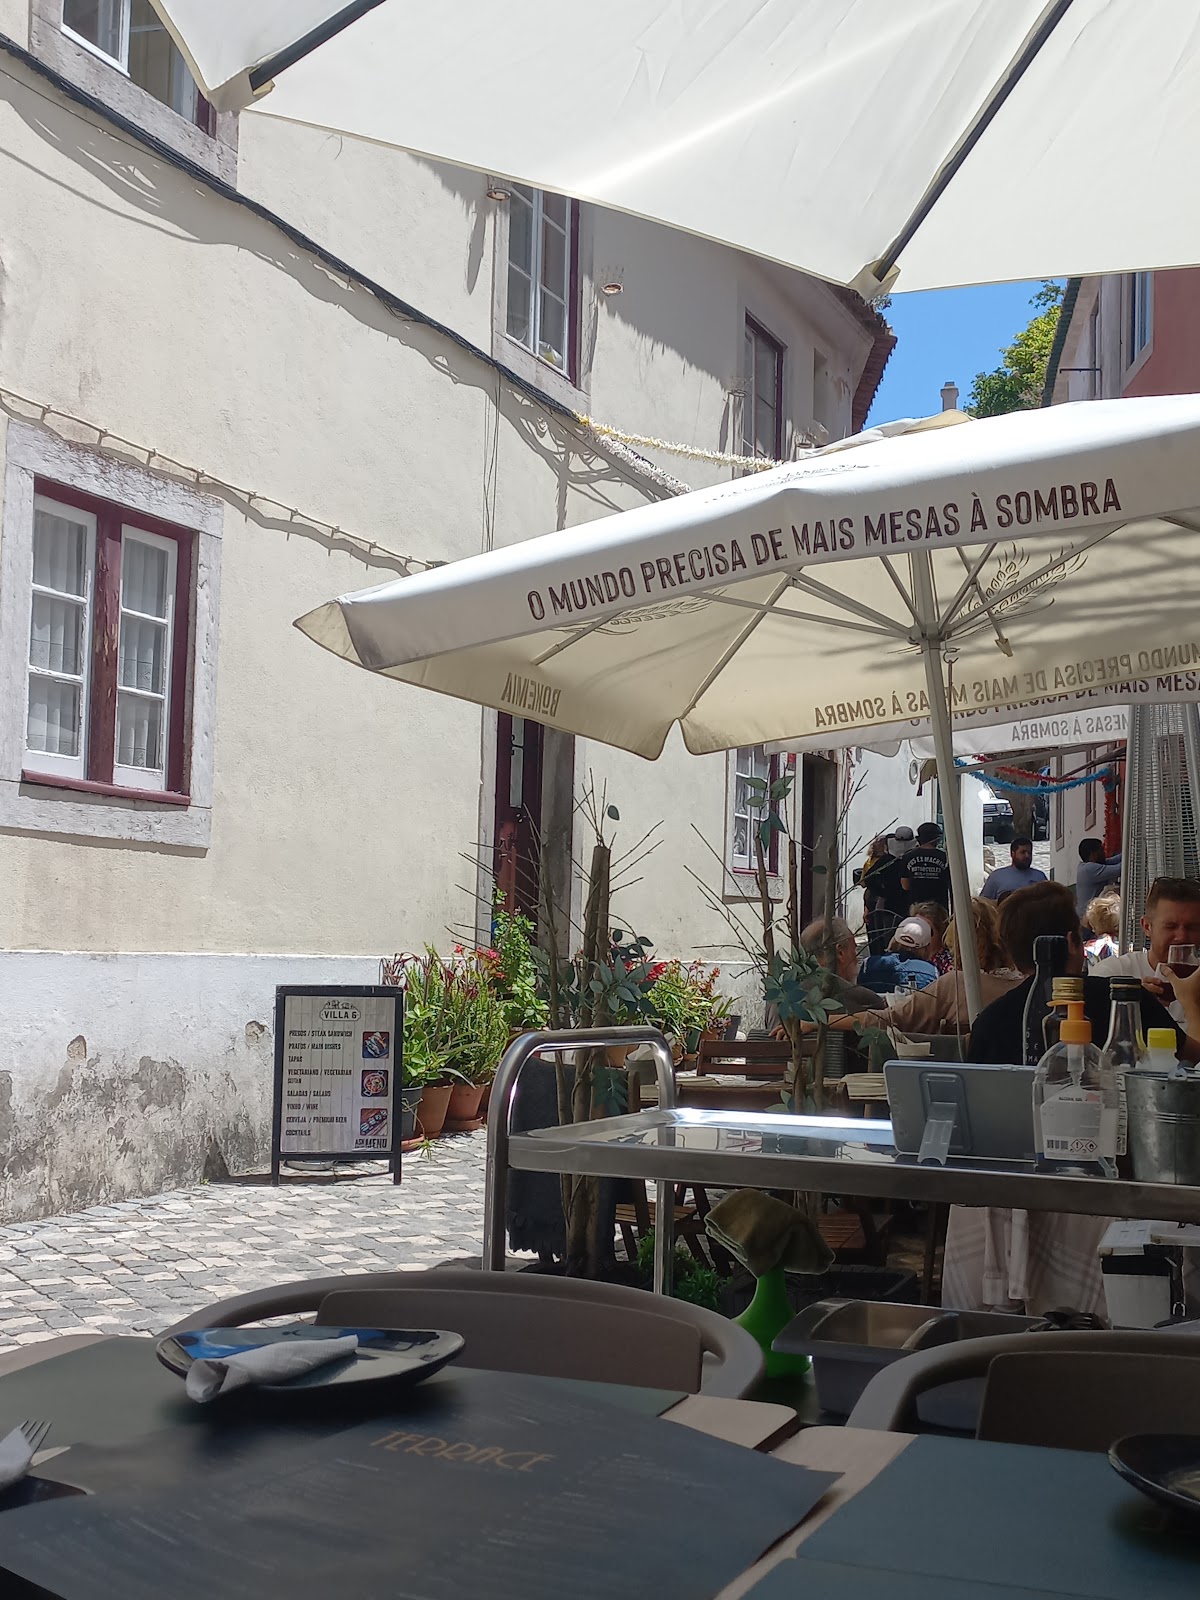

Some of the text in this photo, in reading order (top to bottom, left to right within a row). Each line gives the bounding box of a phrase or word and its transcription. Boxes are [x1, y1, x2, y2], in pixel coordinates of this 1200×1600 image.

[527, 477, 1122, 621] O MUNDO PRECISA DE MAIS MESAS À SOMBRA
[324, 1010, 349, 1019] VILLA
[288, 1055, 303, 1063] TAPAS
